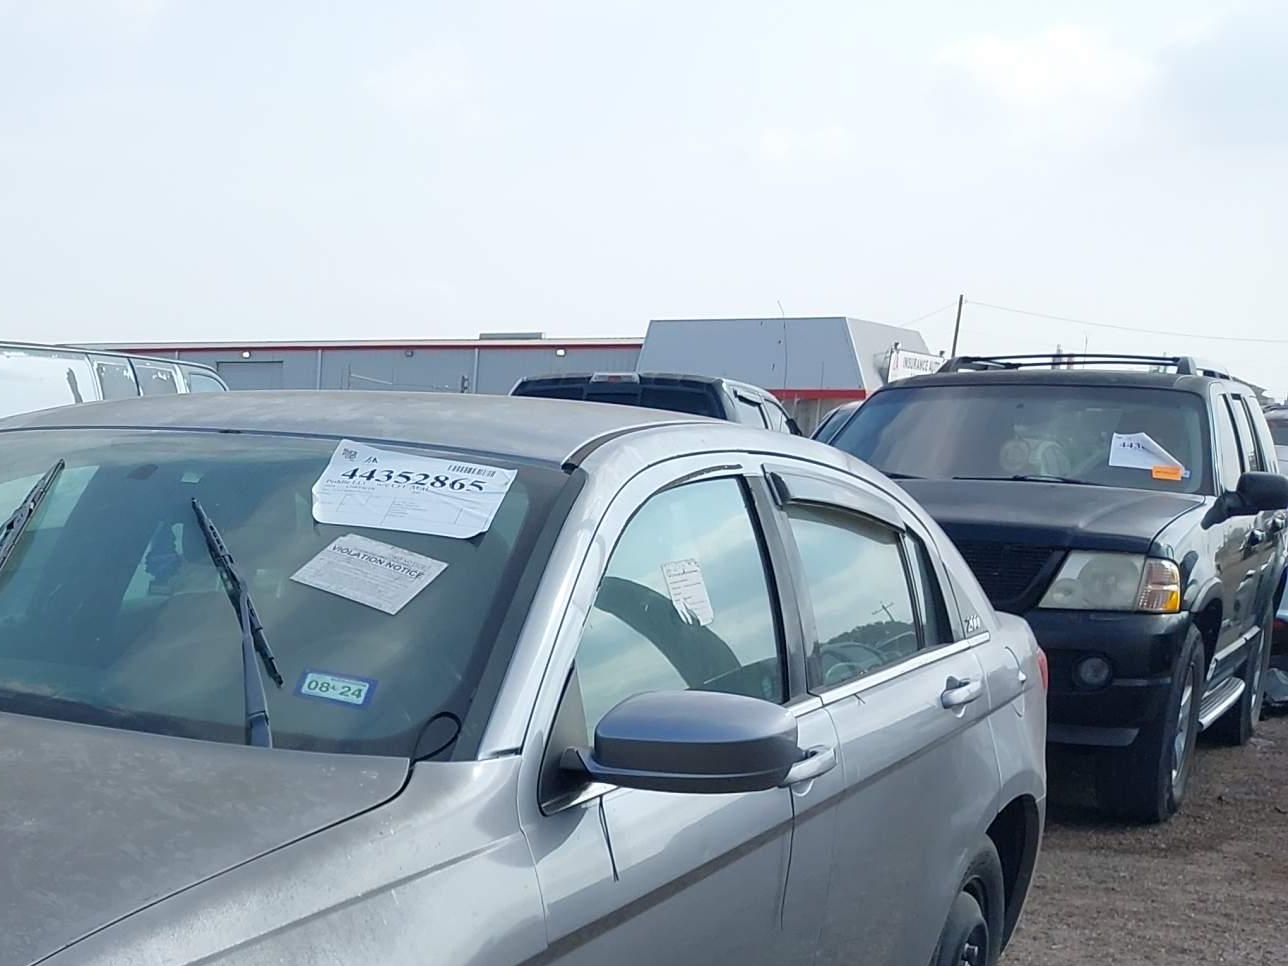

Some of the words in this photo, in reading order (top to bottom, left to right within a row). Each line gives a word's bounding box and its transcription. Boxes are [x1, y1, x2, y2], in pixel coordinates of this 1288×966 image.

[340, 466, 488, 493] 44352865
[331, 545, 385, 567] VIOLATION
[385, 561, 425, 579] NOTICE
